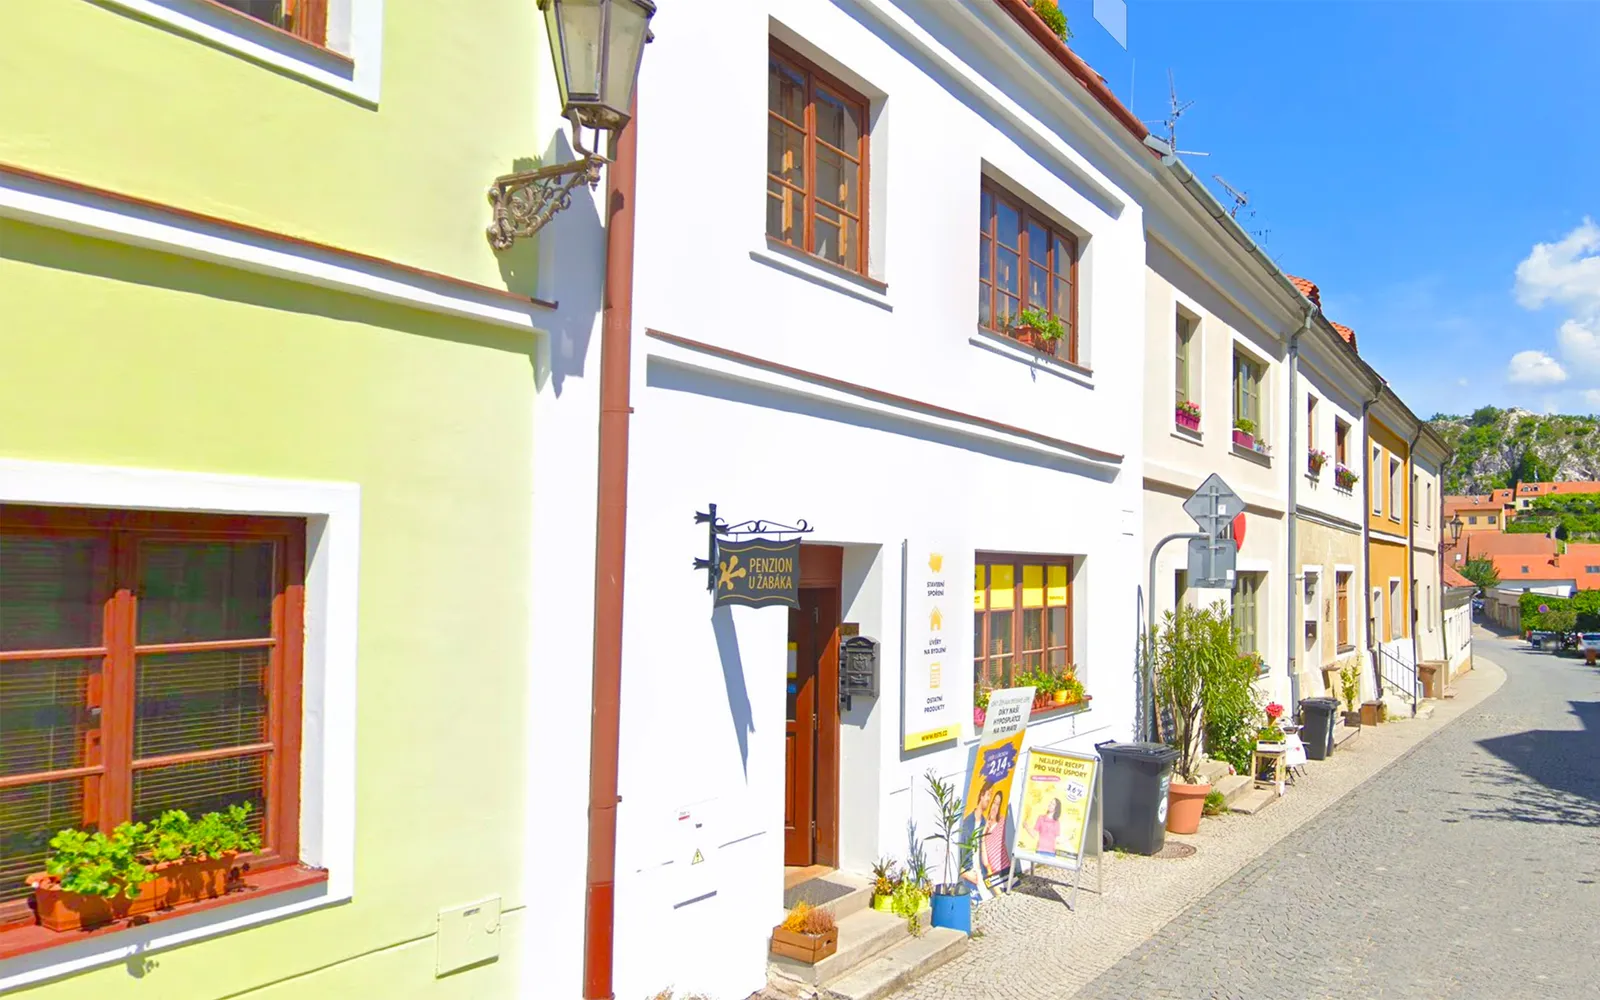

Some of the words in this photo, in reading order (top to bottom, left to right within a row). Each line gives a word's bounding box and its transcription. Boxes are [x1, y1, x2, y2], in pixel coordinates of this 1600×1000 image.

[749, 558, 793, 573] PENZION
[748, 576, 755, 589] U
[757, 573, 793, 589] ŽABÁKA
[924, 704, 944, 713] PRODUKTY
[1064, 761, 1084, 769] RECEPT
